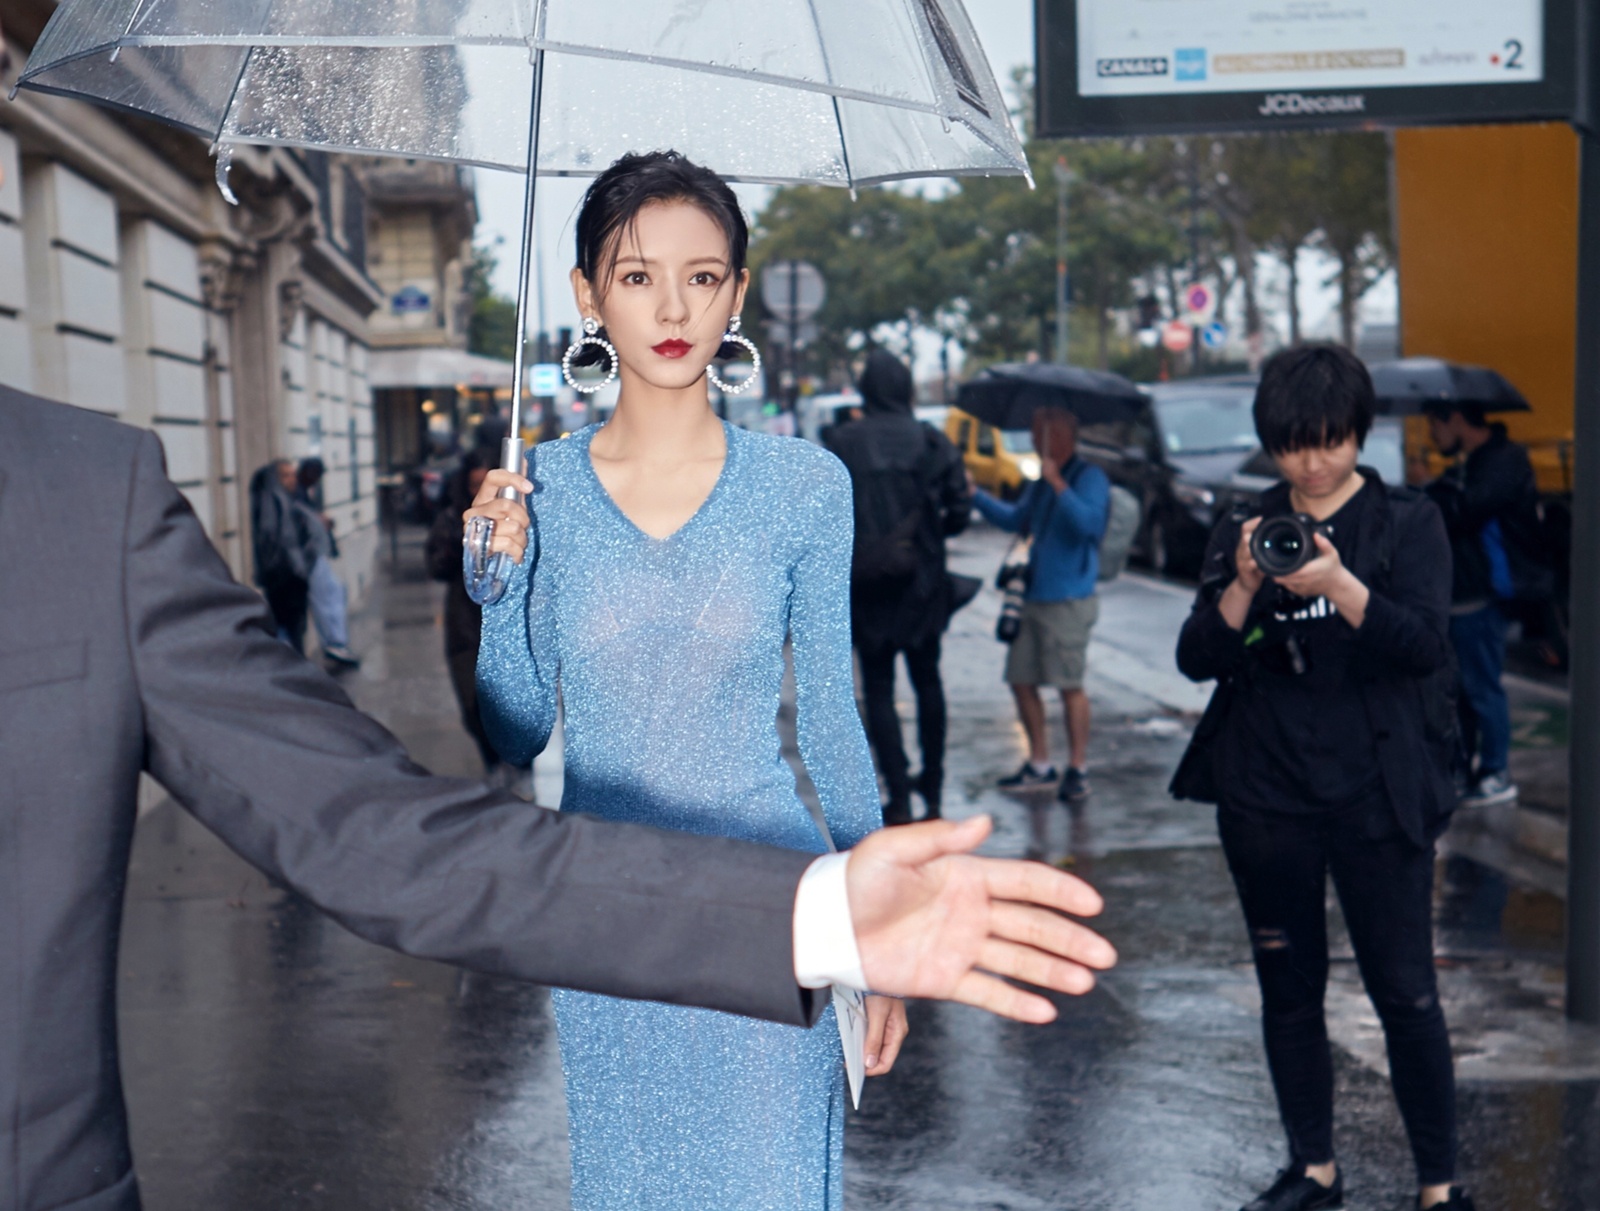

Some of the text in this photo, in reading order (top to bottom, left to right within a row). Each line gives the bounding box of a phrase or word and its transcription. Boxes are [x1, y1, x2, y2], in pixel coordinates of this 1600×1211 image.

[1503, 39, 1523, 69] 2
[1100, 60, 1165, 75] CANAL+
[1259, 93, 1365, 115] JCDecaux
